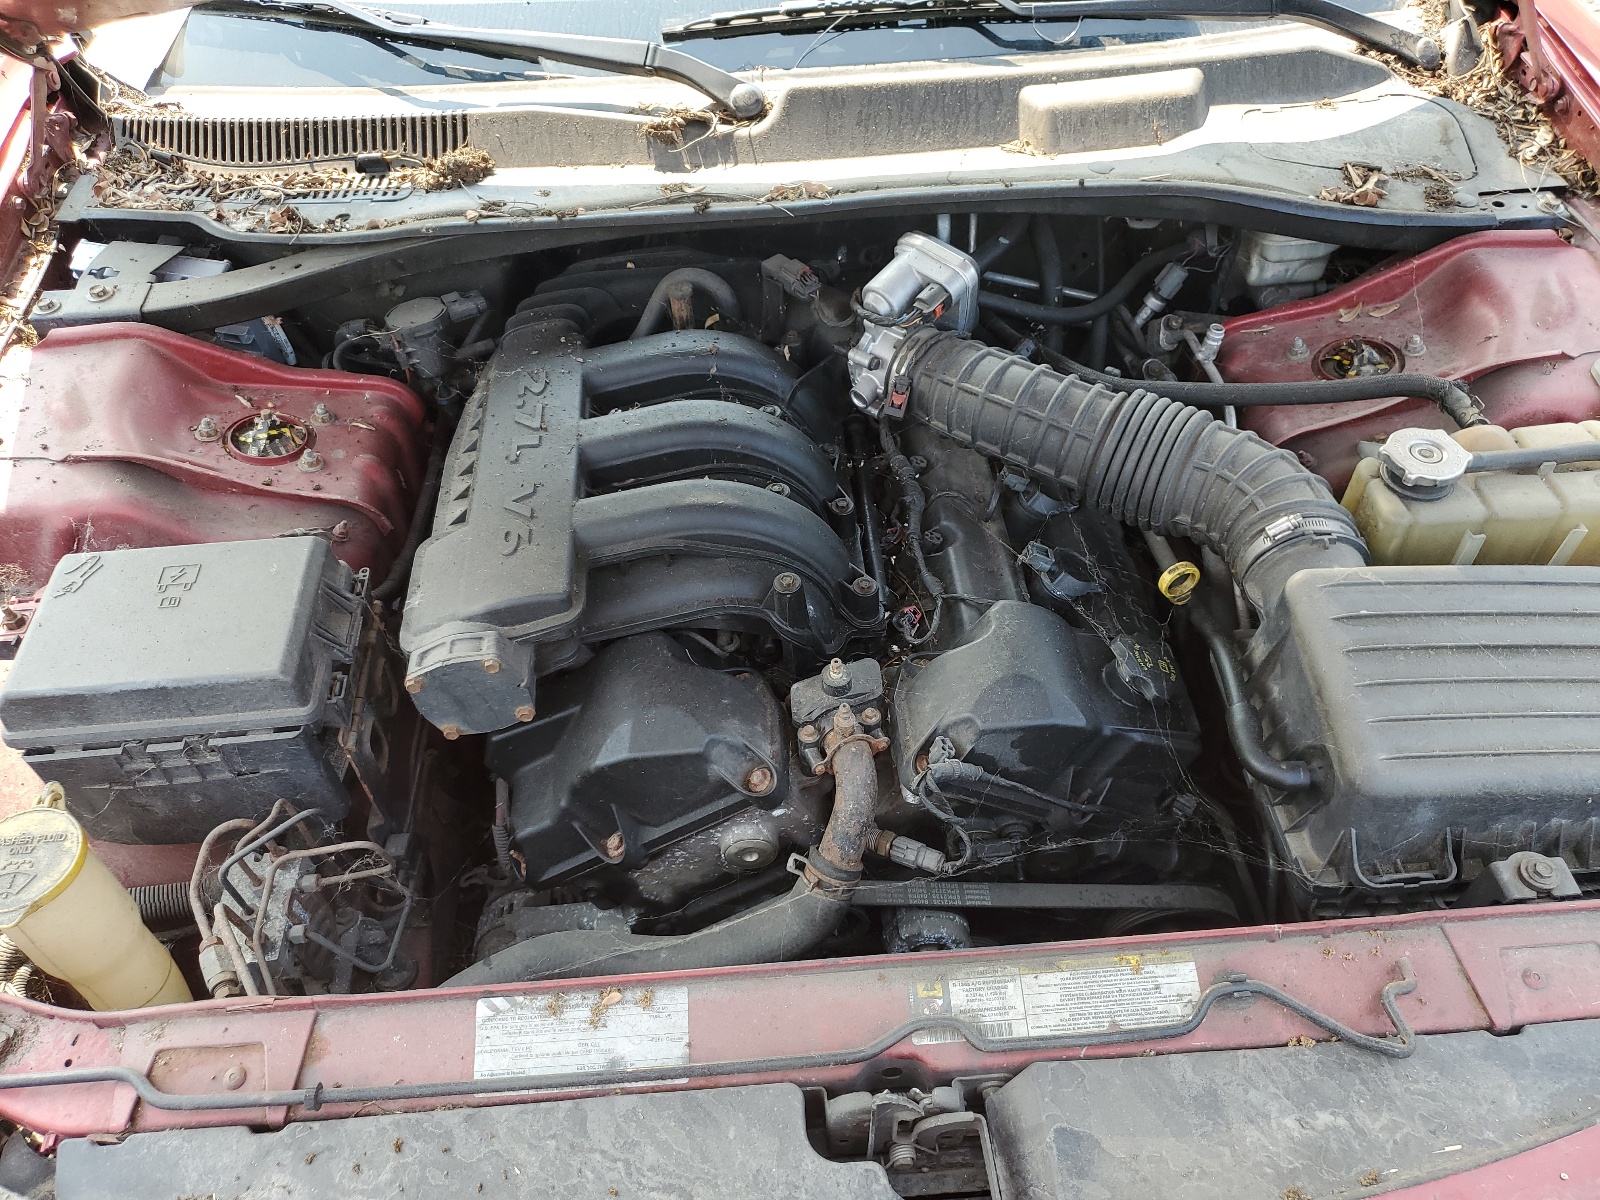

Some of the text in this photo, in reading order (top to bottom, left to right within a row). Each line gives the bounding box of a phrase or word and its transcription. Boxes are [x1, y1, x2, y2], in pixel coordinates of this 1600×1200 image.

[501, 483, 542, 558] V6
[0, 832, 68, 846] ASHER FLUID
[9, 844, 36, 855] ONLY
